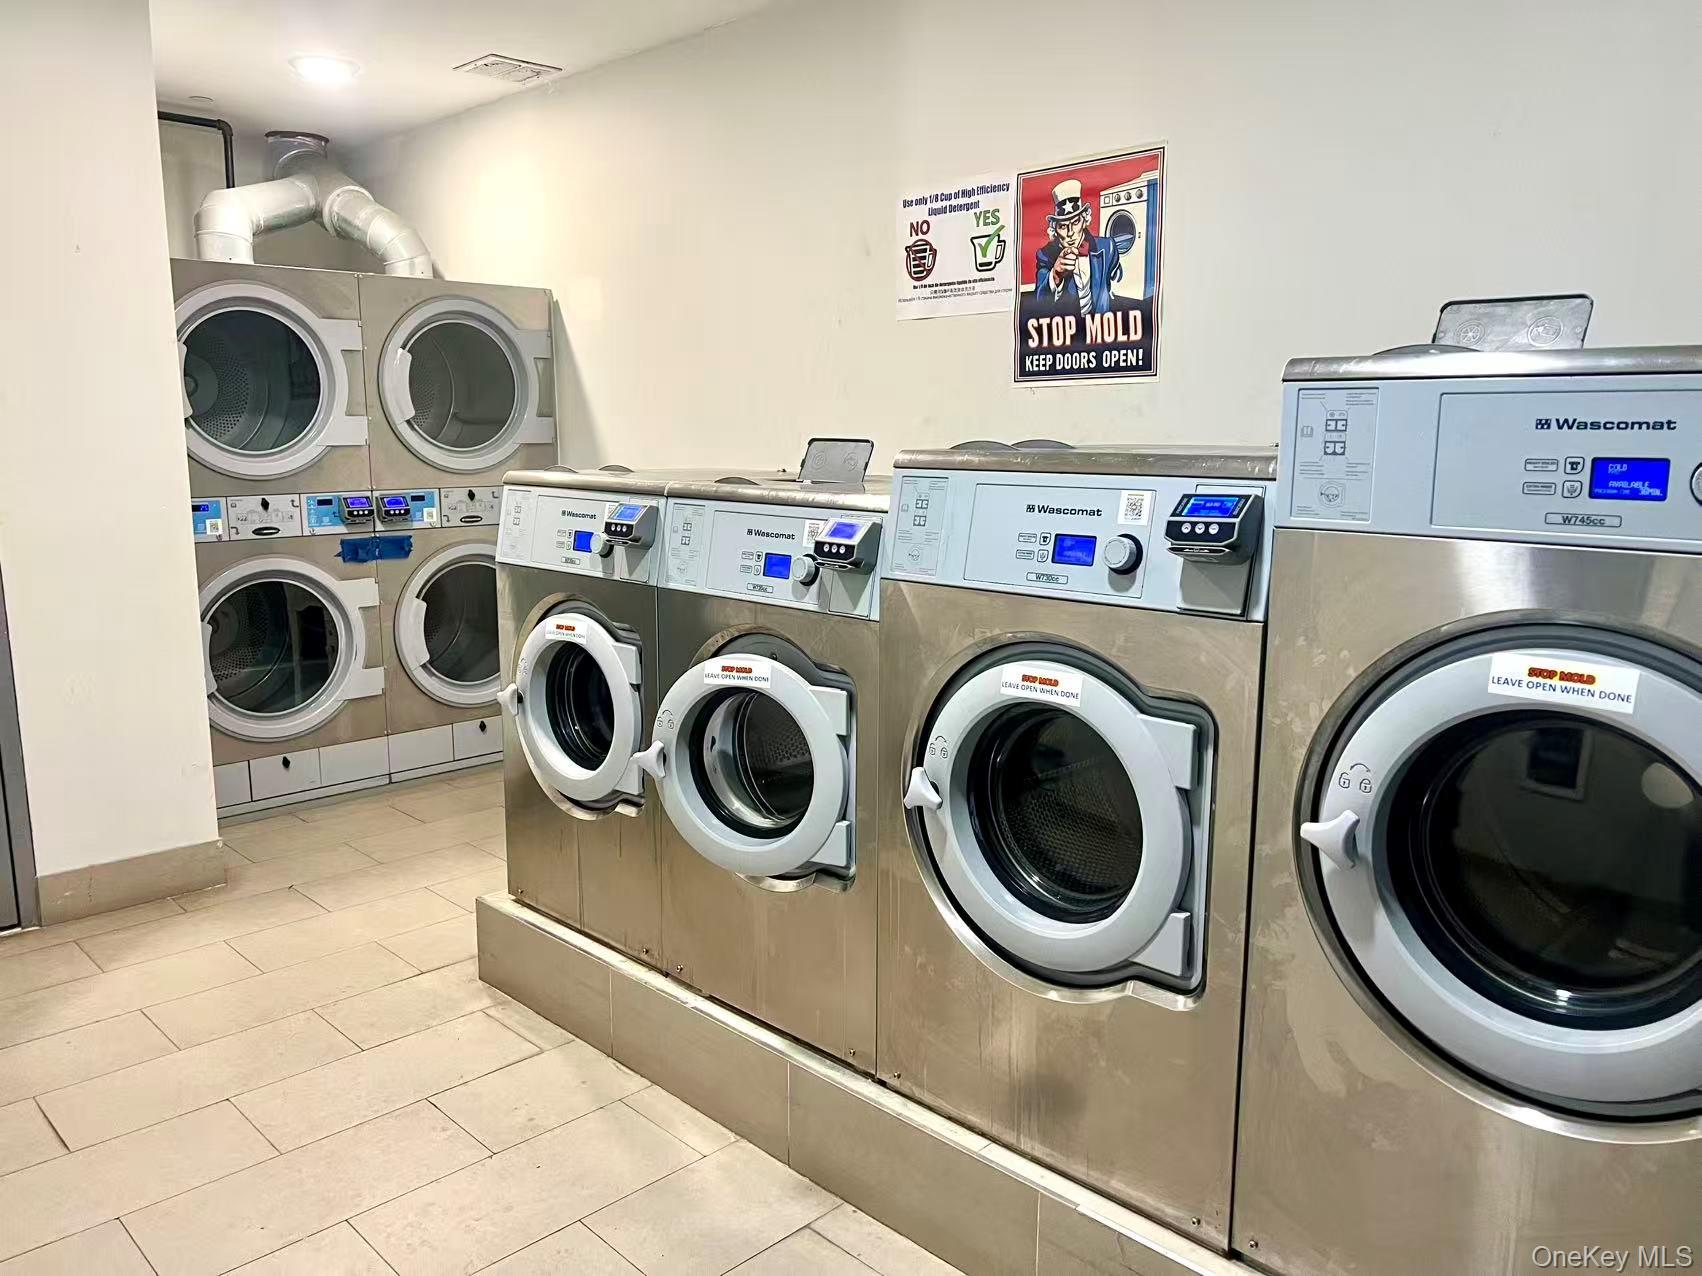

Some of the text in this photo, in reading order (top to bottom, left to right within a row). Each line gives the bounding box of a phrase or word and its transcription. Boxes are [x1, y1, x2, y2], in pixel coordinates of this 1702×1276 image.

[903, 182, 1010, 208] Use only 1/8 Cup of High Efficiency
[928, 200, 980, 216] Liquid Detergent
[974, 208, 1000, 227] YES
[909, 219, 931, 237] NO
[1027, 310, 1143, 348] STOP MOLD
[1025, 348, 1144, 371] KEEP DOORS OPEN!
[1555, 418, 1677, 430] Wascomat
[566, 510, 597, 520] Wascomat
[1037, 504, 1103, 517] Wascomat
[1561, 515, 1606, 526] W745cc
[753, 529, 795, 540] Wascomat
[1528, 667, 1596, 685] STOP MOLD
[1001, 681, 1080, 699] LEAVE OPEN WHEN DONE
[1492, 676, 1632, 703] LEAVE OPEN WHEN DONE
